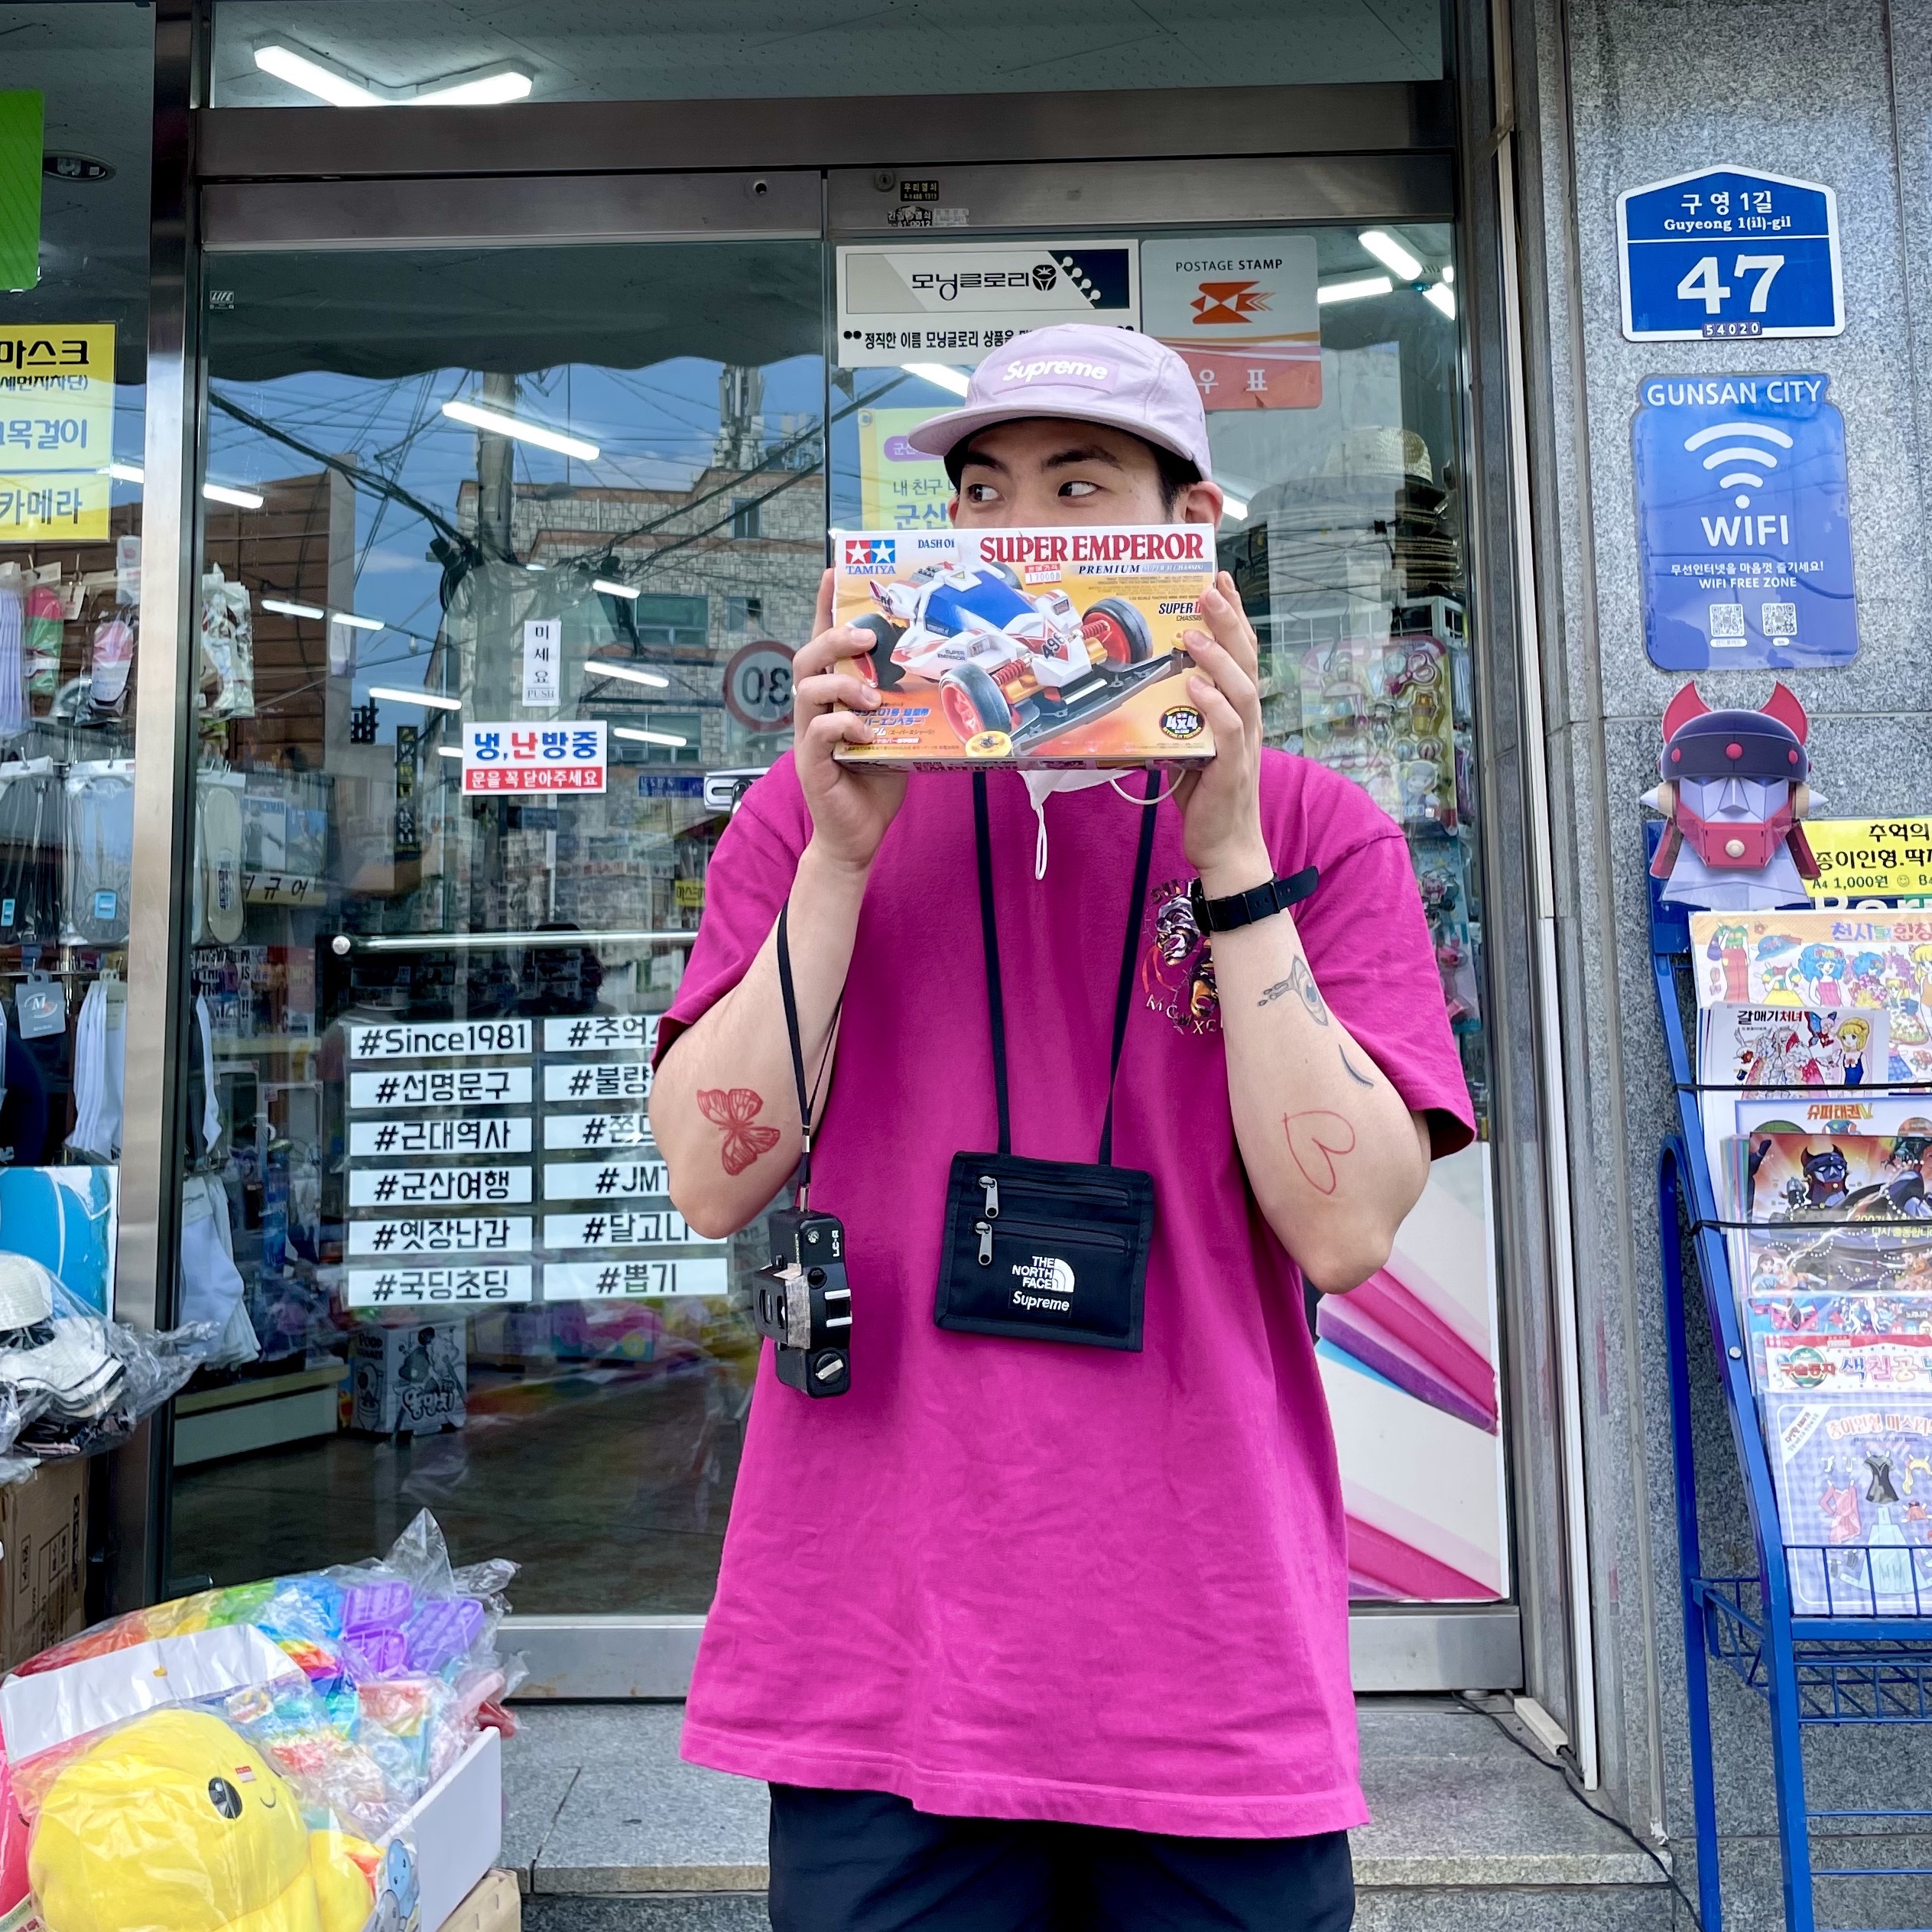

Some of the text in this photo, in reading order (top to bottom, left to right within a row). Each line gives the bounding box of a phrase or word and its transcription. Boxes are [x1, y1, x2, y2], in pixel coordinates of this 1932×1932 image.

[1664, 216, 1791, 232] Guyeong 1(il)-gil
[1176, 259, 1283, 271] POSTAGE STAMP
[912, 272, 1029, 300] 모닝글로리
[1677, 255, 1784, 314] 47
[865, 333, 896, 349] 정직한
[901, 330, 921, 349] 이름
[927, 330, 979, 349] 모닝글로리
[1706, 323, 1759, 336] 54020
[1002, 359, 1108, 382] Supreme
[1648, 380, 1821, 406] GUNSAN CITY
[0, 418, 87, 450] 목걸이
[893, 480, 908, 496] 내
[912, 479, 943, 495] 친구
[1700, 515, 1789, 547] WIFI
[918, 539, 942, 549] DASH
[980, 533, 1203, 563] SUPER EMPEROR
[846, 565, 896, 574] TAMIYA
[1079, 564, 1141, 574] PREMIUM
[1671, 560, 1824, 576] 무선인터넷을 마음껏 즐기세요!
[1699, 576, 1797, 589] WIFI FREE ZONE
[1159, 602, 1193, 615] SUPER
[534, 625, 549, 684] 미세요
[1042, 634, 1065, 659] 496
[475, 731, 598, 761] 냉,난방중
[472, 770, 598, 788] 문을 꼭 닫아주세요
[1869, 823, 1930, 843] 추억의
[1834, 875, 1888, 890] 1,000원
[359, 1024, 525, 1056] #Since1981
[375, 1072, 511, 1104] #선명문구
[375, 1121, 511, 1152] #근대역사
[374, 1171, 509, 1201] #군산여행
[372, 1219, 510, 1251] #옛장난감
[1032, 1255, 1054, 1268] THE
[596, 1263, 677, 1294] #뽑기
[1012, 1265, 1054, 1279] NORTH
[372, 1270, 508, 1301] #국딩초딩
[1022, 1277, 1052, 1290] FACE
[1012, 1291, 1070, 1311] Supreme
